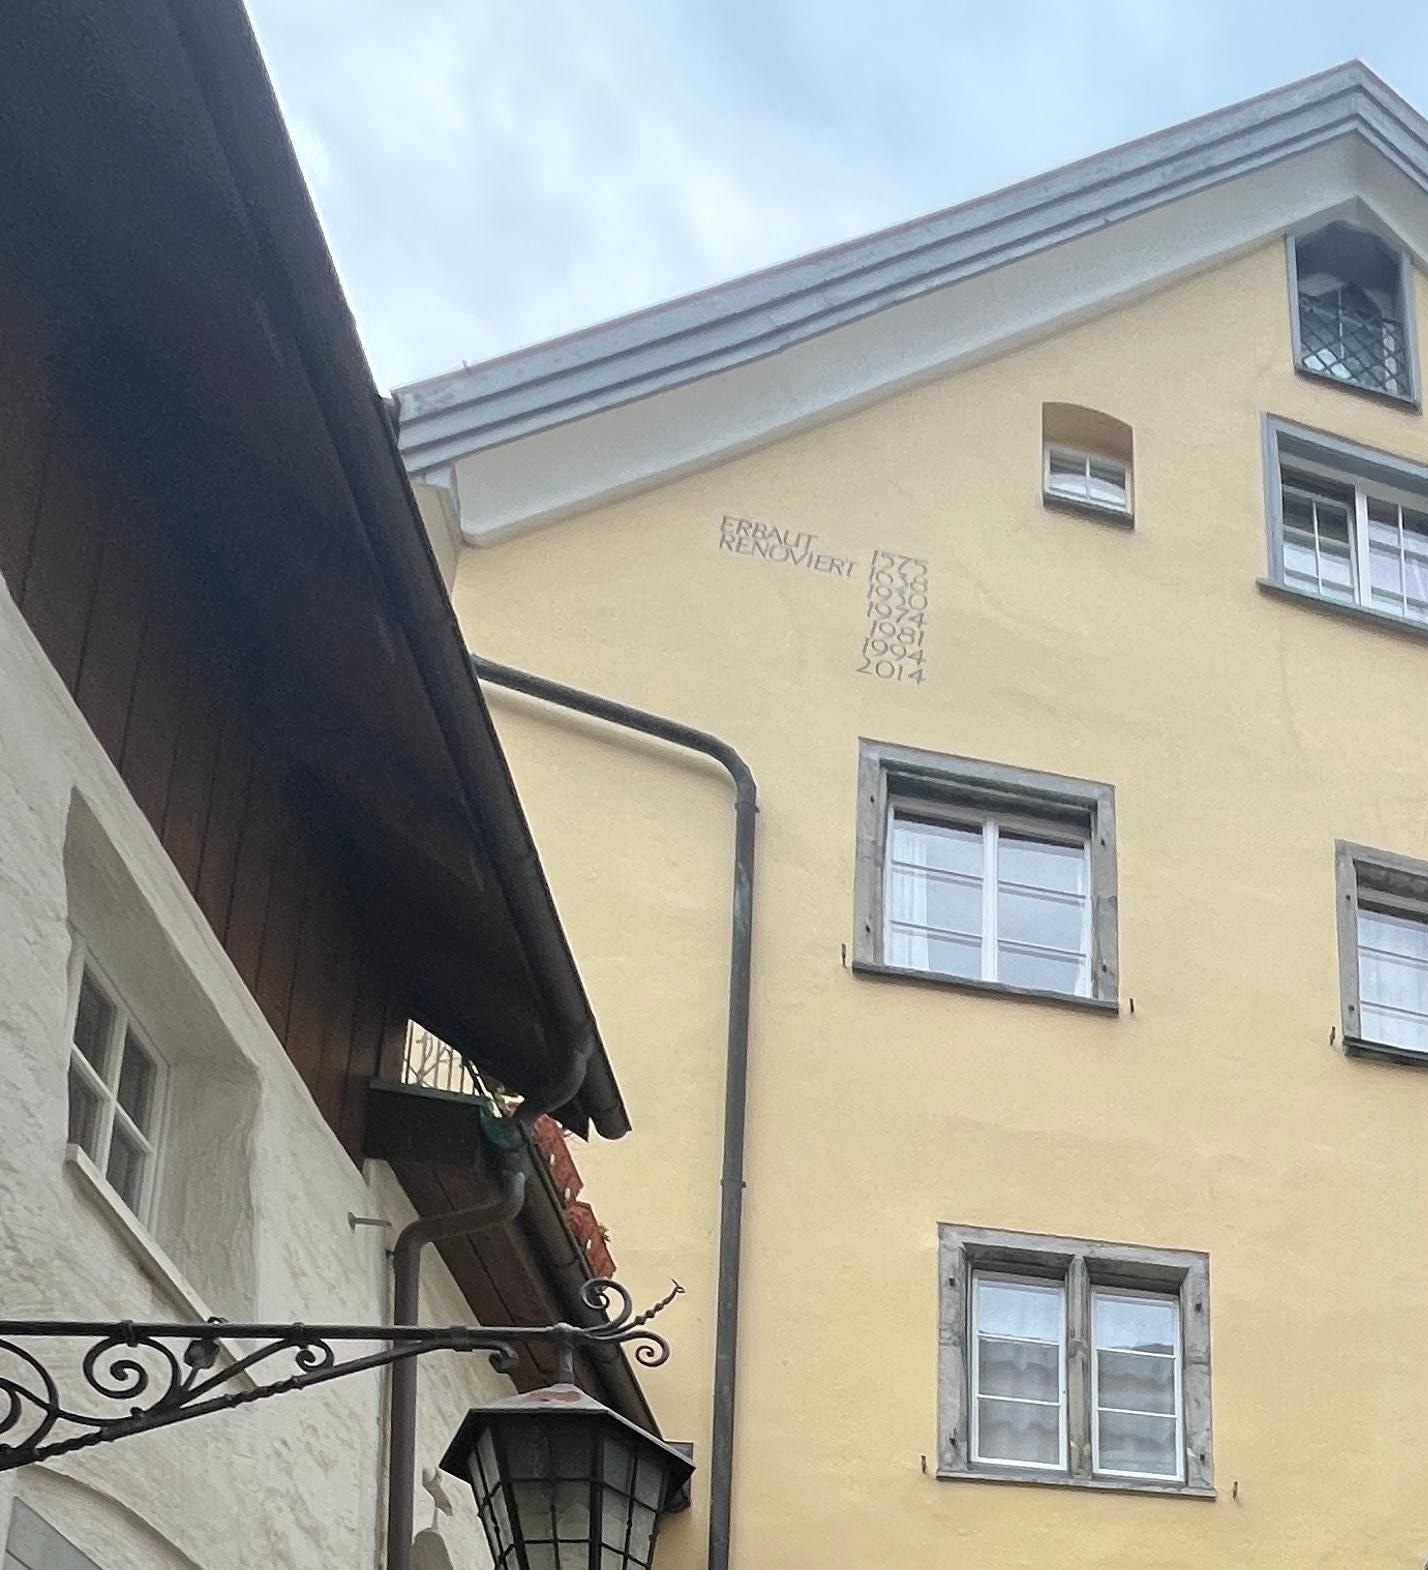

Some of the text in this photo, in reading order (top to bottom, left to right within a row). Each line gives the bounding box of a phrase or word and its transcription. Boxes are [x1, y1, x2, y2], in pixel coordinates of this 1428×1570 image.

[720, 515, 819, 551] ERBAUT
[719, 534, 859, 577] RENOVIERT
[867, 601, 927, 629] 1974
[870, 620, 925, 647] 1981
[862, 637, 927, 667] 1994
[856, 655, 927, 685] 2014
